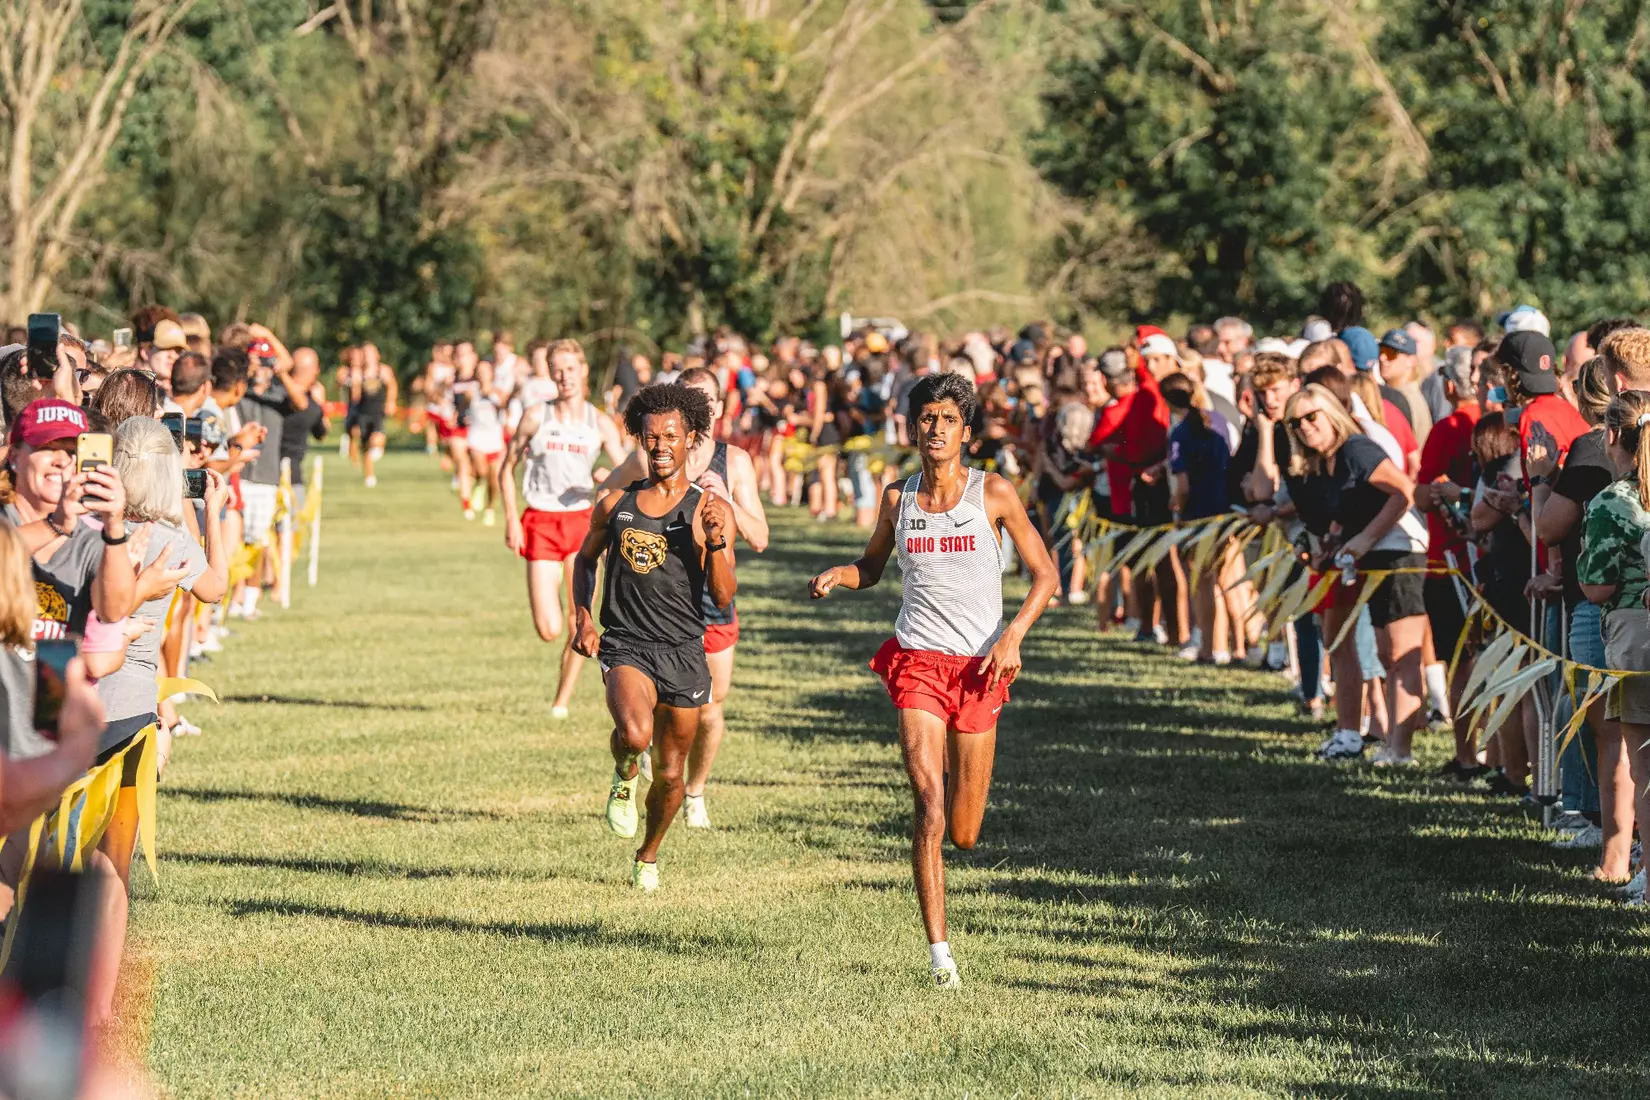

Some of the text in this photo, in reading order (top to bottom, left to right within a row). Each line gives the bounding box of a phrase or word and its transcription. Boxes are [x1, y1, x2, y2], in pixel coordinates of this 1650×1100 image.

[36, 406, 85, 429] IUPUI
[907, 535, 976, 553] OHIO STATE
